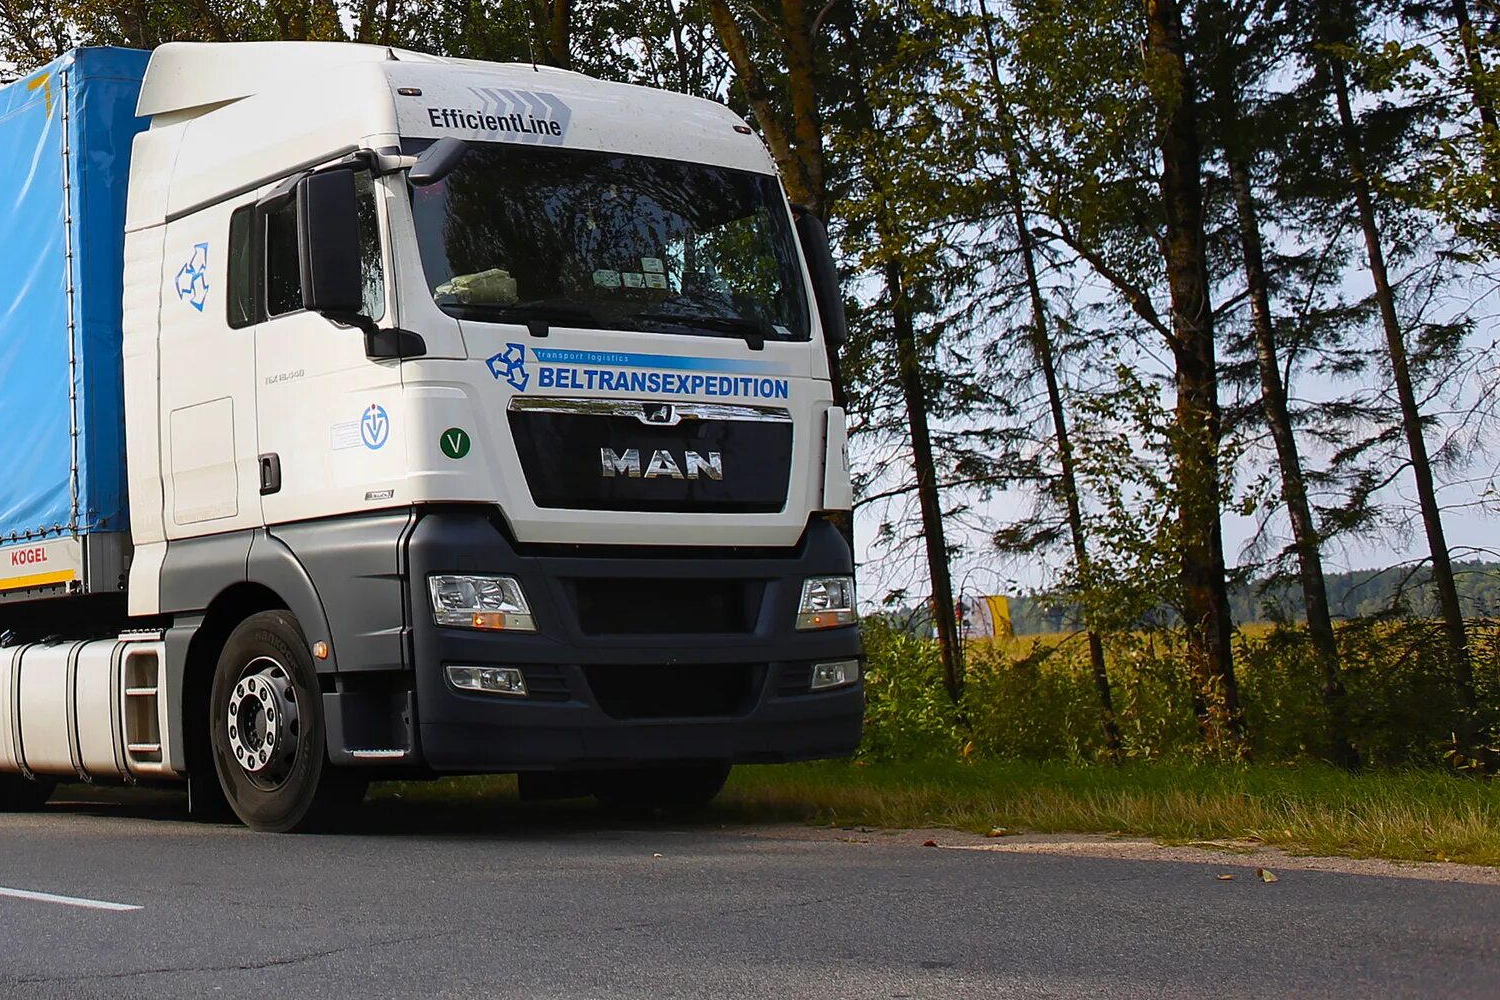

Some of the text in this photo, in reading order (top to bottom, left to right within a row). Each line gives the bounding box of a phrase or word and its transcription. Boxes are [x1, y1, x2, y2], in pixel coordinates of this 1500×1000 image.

[427, 108, 562, 136] EfficientLine
[537, 351, 629, 362] transport logistics
[538, 367, 788, 399] BELTRANSEXPEDITION
[446, 432, 462, 454] V
[600, 447, 724, 480] MAN
[11, 547, 48, 566] KÖGEL
